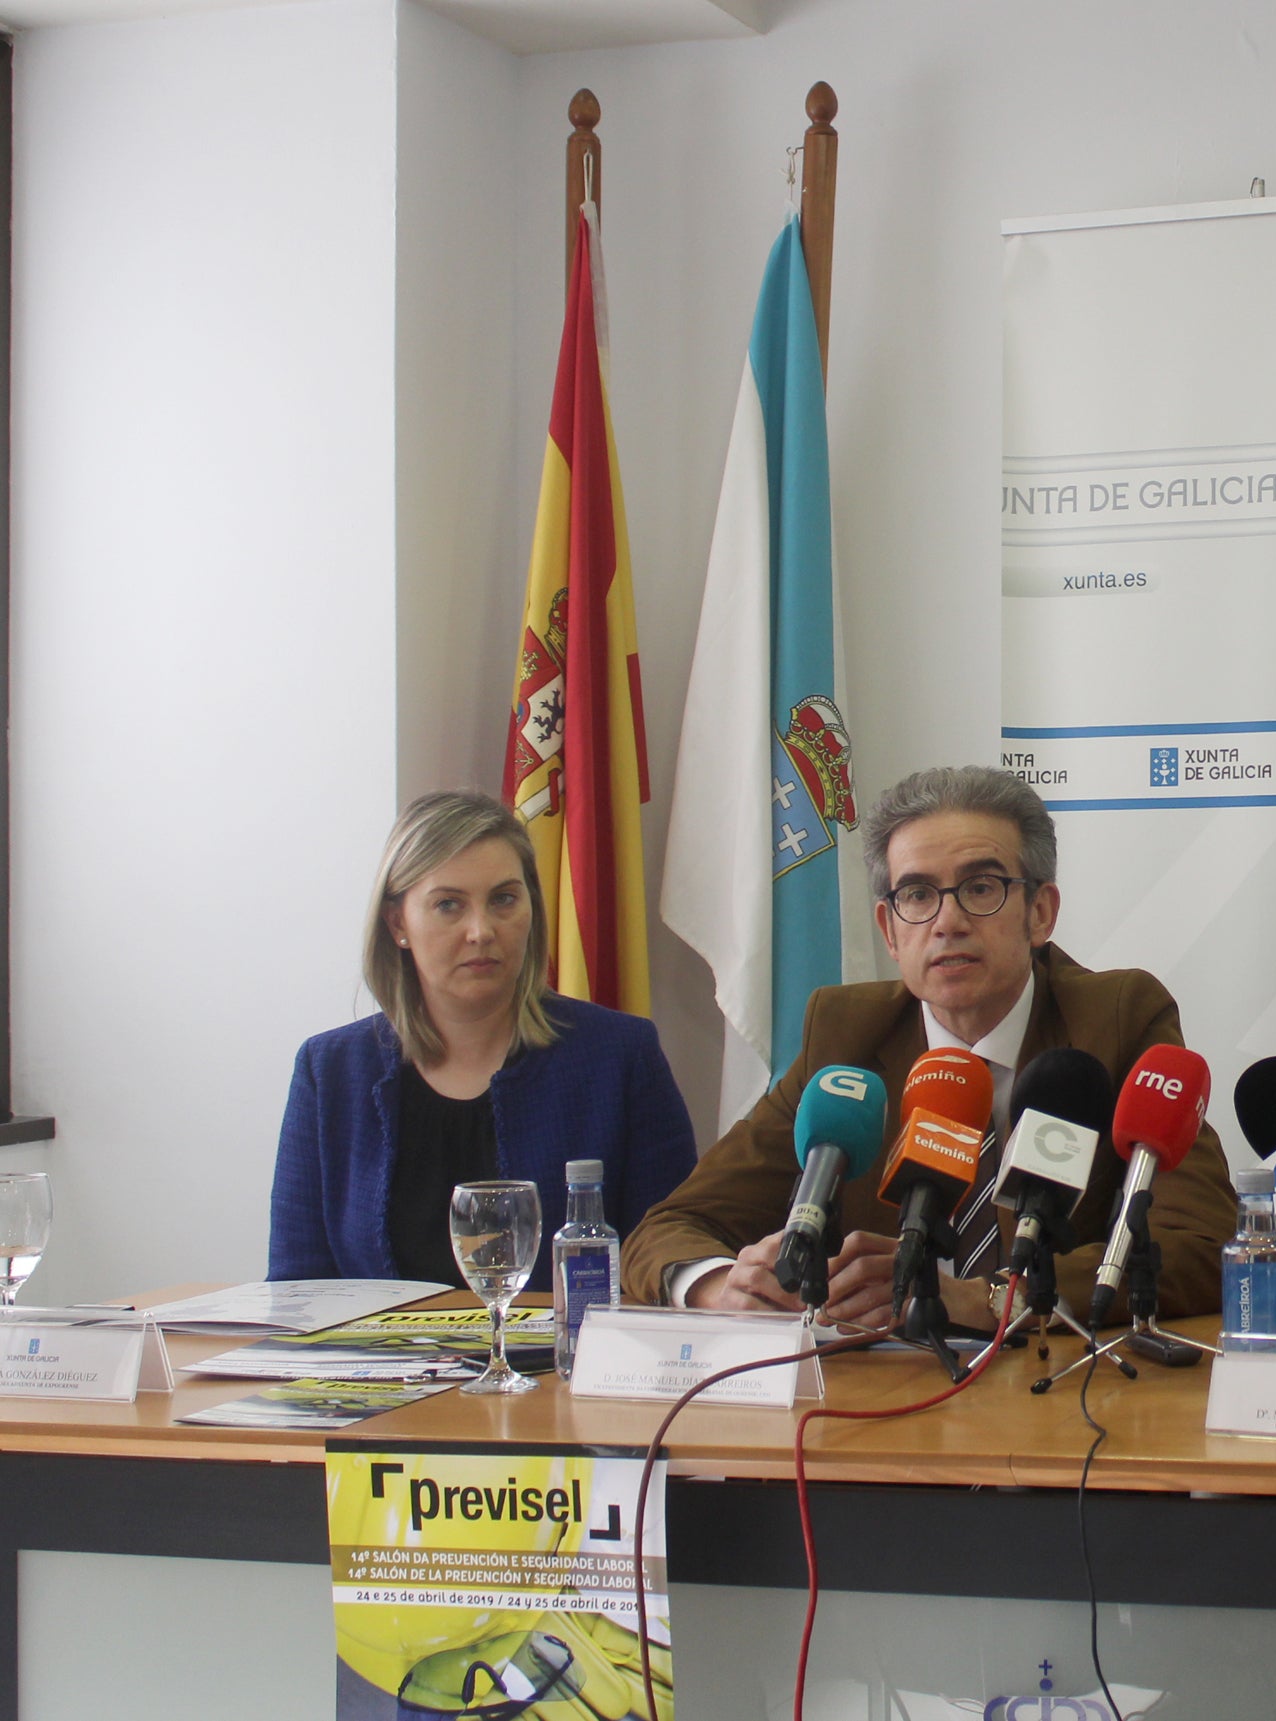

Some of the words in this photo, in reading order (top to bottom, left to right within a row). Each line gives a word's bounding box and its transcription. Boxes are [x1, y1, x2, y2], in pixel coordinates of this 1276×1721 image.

[1089, 482, 1129, 512] DE
[1063, 569, 1147, 591] xunta.es
[1001, 753, 1034, 768] NTA
[1185, 749, 1239, 763] XUNTA
[1185, 767, 1204, 780] DE
[1209, 764, 1272, 780] GALICIA
[1135, 1070, 1183, 1100] rne
[914, 1134, 975, 1165] telemiño
[638, 1374, 680, 1385] MANUEL
[410, 1477, 582, 1531] previsel
[373, 1549, 410, 1564] SALÓN
[413, 1552, 429, 1564] DA
[511, 1556, 518, 1567] E
[521, 1556, 594, 1570] SEGURIDADE
[597, 1559, 648, 1574] LABORL
[370, 1566, 407, 1580] SALÓN
[410, 1568, 425, 1580] DE
[429, 1569, 442, 1581] LA
[525, 1572, 532, 1584] Y
[534, 1572, 599, 1587] SEGURIDAD
[357, 1591, 370, 1601] 24
[373, 1592, 380, 1600] e
[383, 1592, 397, 1602] 25
[400, 1590, 414, 1602] de
[418, 1591, 446, 1603] abril
[449, 1592, 464, 1604] de
[467, 1595, 494, 1606] 2019
[507, 1597, 521, 1607] 24
[524, 1598, 532, 1610] y
[535, 1597, 548, 1608] 25
[552, 1597, 566, 1608] de
[570, 1597, 599, 1610] abril
[602, 1598, 616, 1610] de
[620, 1601, 639, 1611] 201
